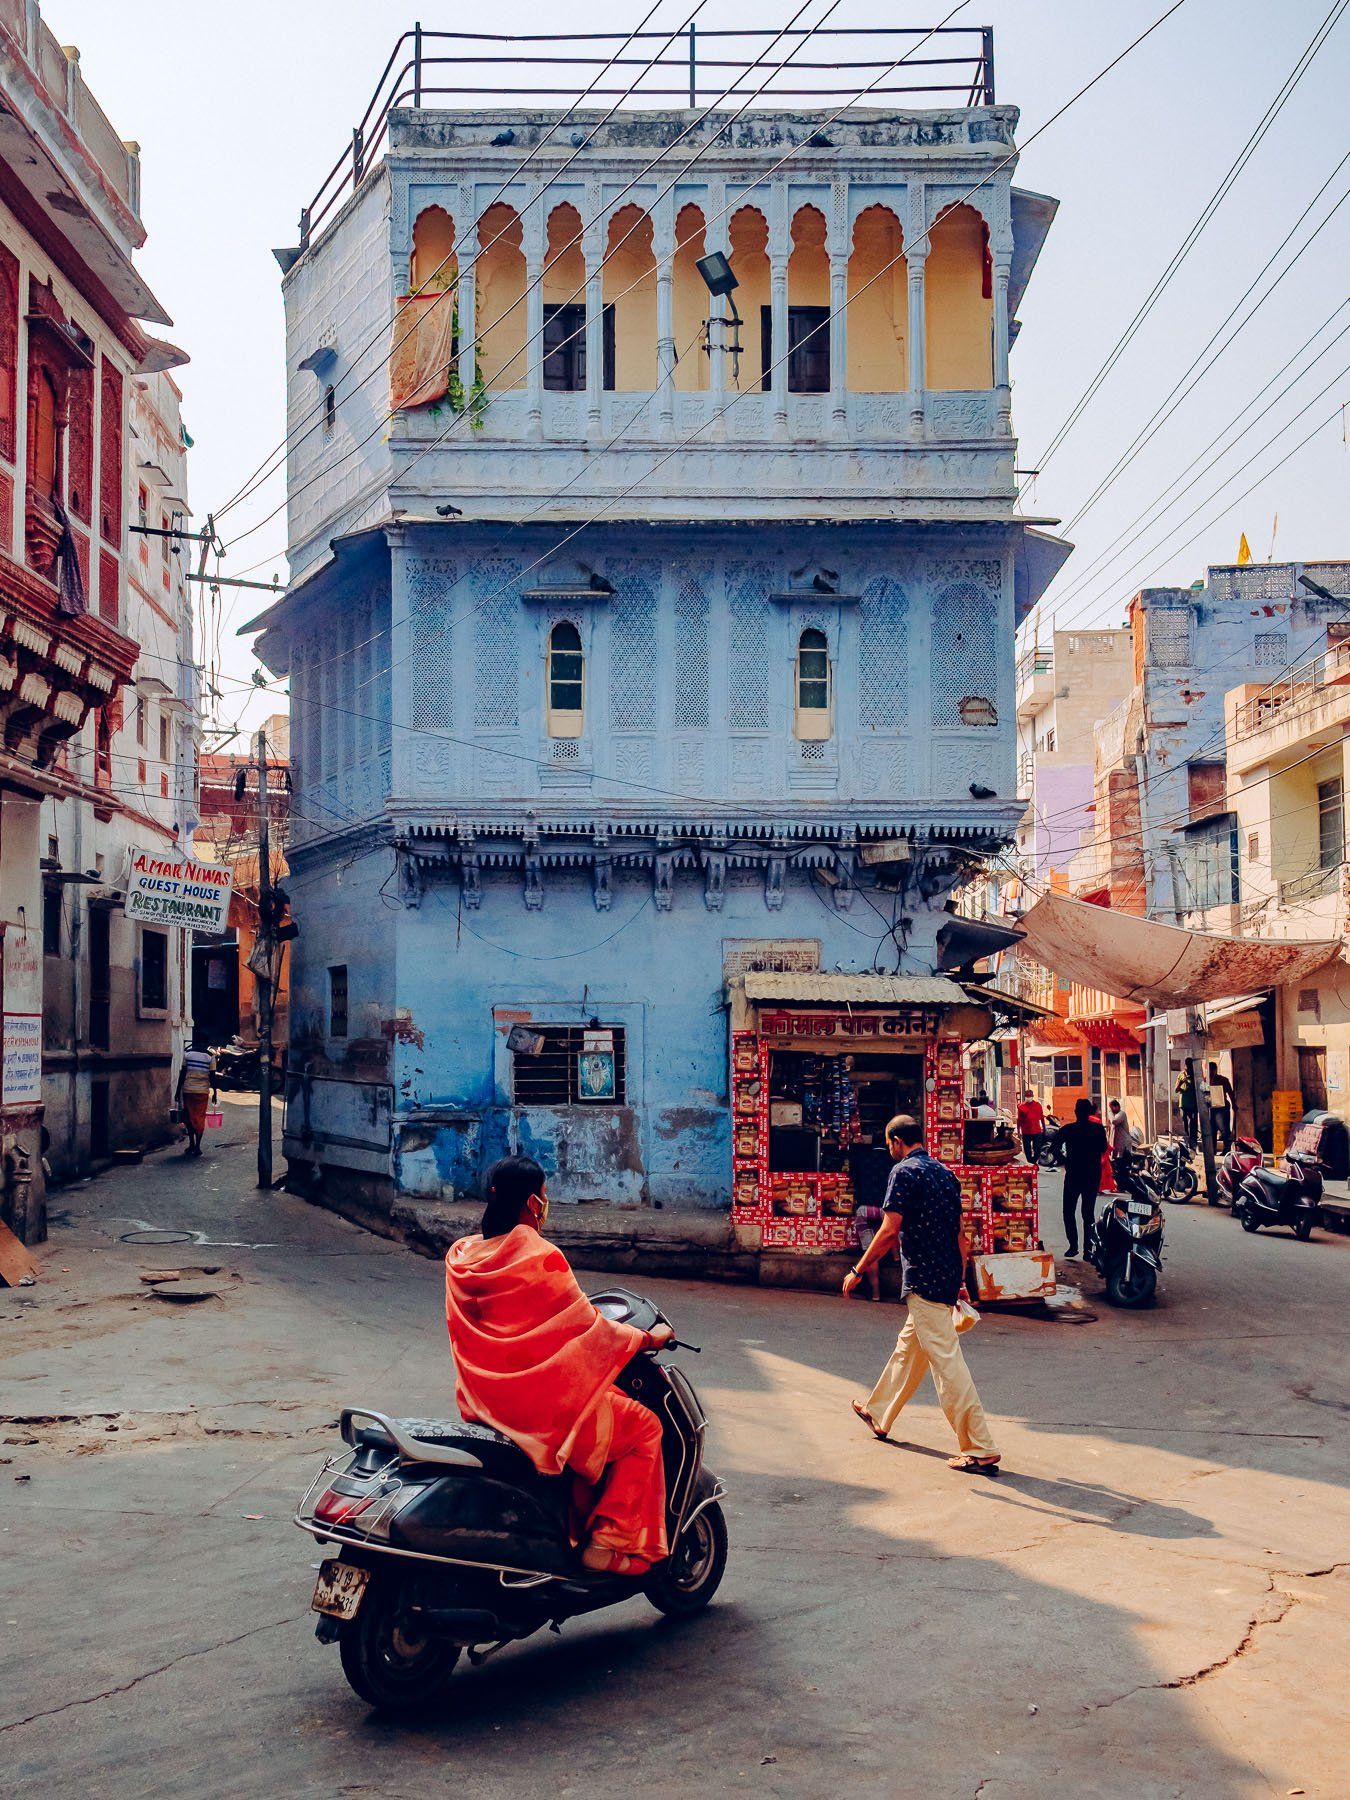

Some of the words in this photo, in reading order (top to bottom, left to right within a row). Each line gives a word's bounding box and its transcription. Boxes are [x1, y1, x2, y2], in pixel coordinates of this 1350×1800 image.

[134, 854, 182, 879] AMAR
[184, 862, 230, 886] NIWAS
[139, 877, 180, 894] GUEST
[183, 885, 221, 901] HOUSE
[130, 890, 223, 922] RESTAURANT
[761, 1010, 836, 1036] कोमल
